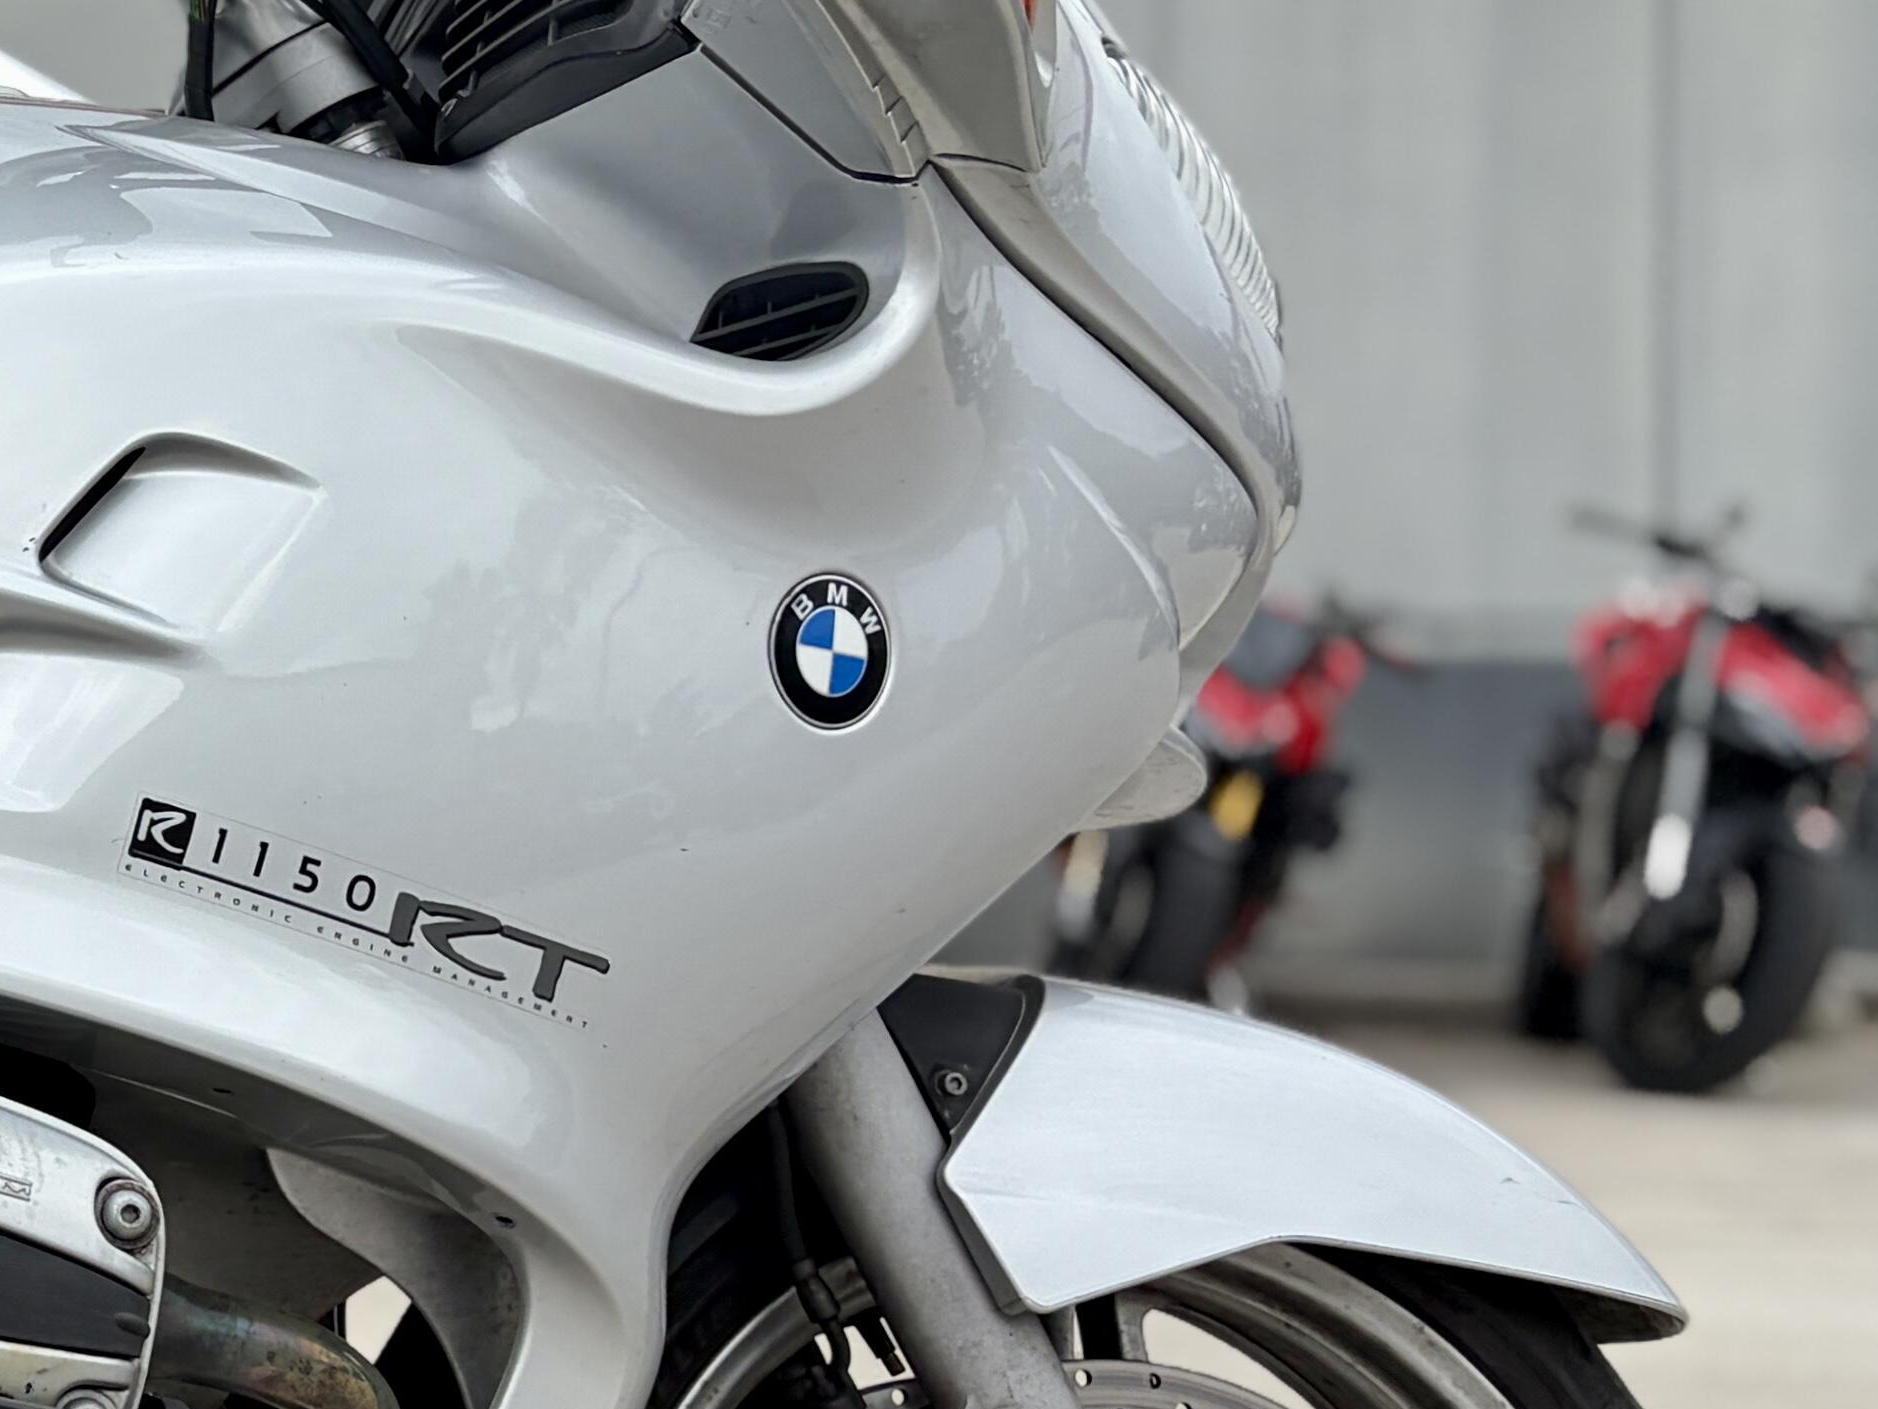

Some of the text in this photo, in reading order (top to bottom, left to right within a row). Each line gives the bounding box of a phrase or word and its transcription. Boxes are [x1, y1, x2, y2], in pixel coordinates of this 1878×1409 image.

[791, 582, 881, 634] BMW
[212, 828, 377, 912] 1150
[389, 892, 610, 1002] RT
